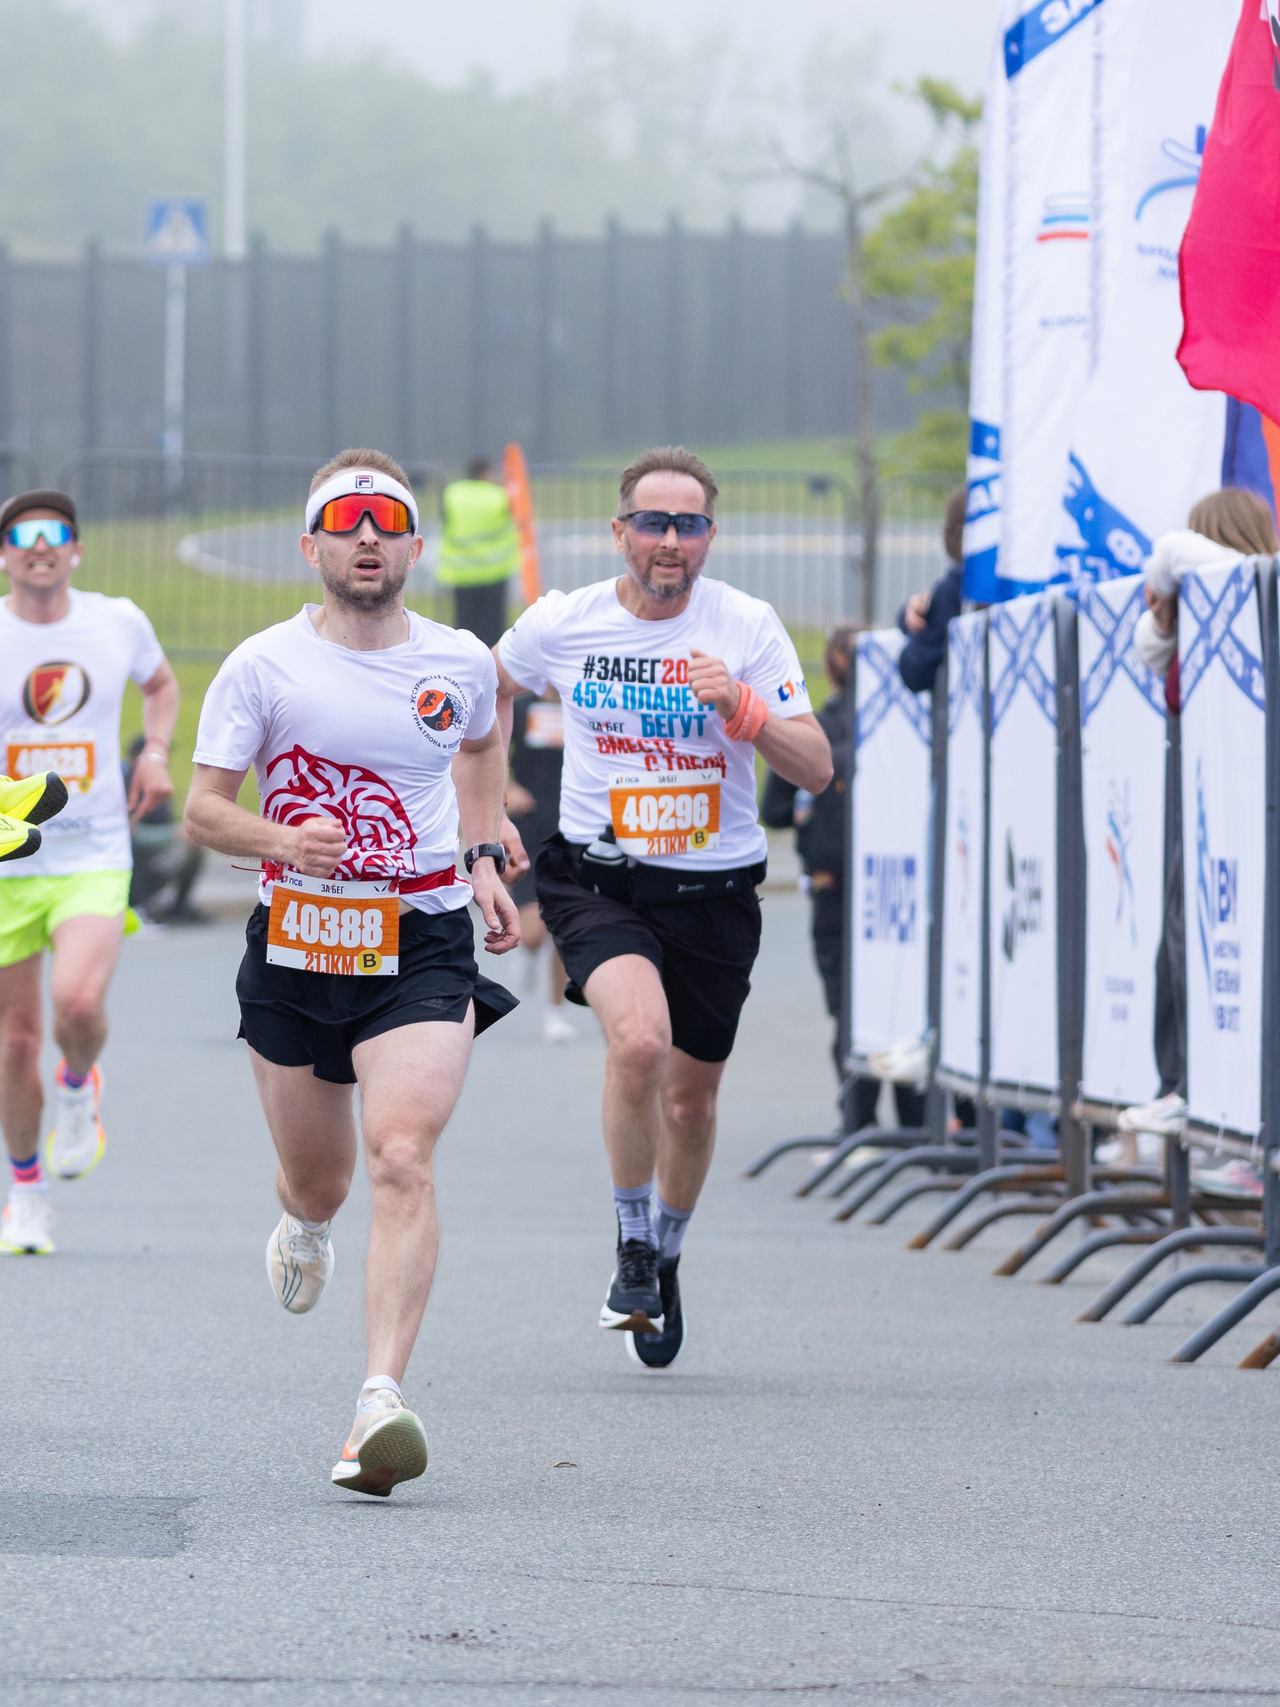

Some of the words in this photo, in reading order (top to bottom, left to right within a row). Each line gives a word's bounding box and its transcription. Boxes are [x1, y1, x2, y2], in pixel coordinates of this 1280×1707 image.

[583, 654, 688, 685] #ЗАБЕГ20
[572, 681, 617, 709] 45%
[412, 713, 441, 748] ТРИАТЛОНА
[640, 713, 707, 738] БЕГУТ
[644, 753, 659, 772] С
[622, 792, 709, 832] 40296
[288, 877, 303, 887] ПСБ
[281, 900, 383, 948] 40388
